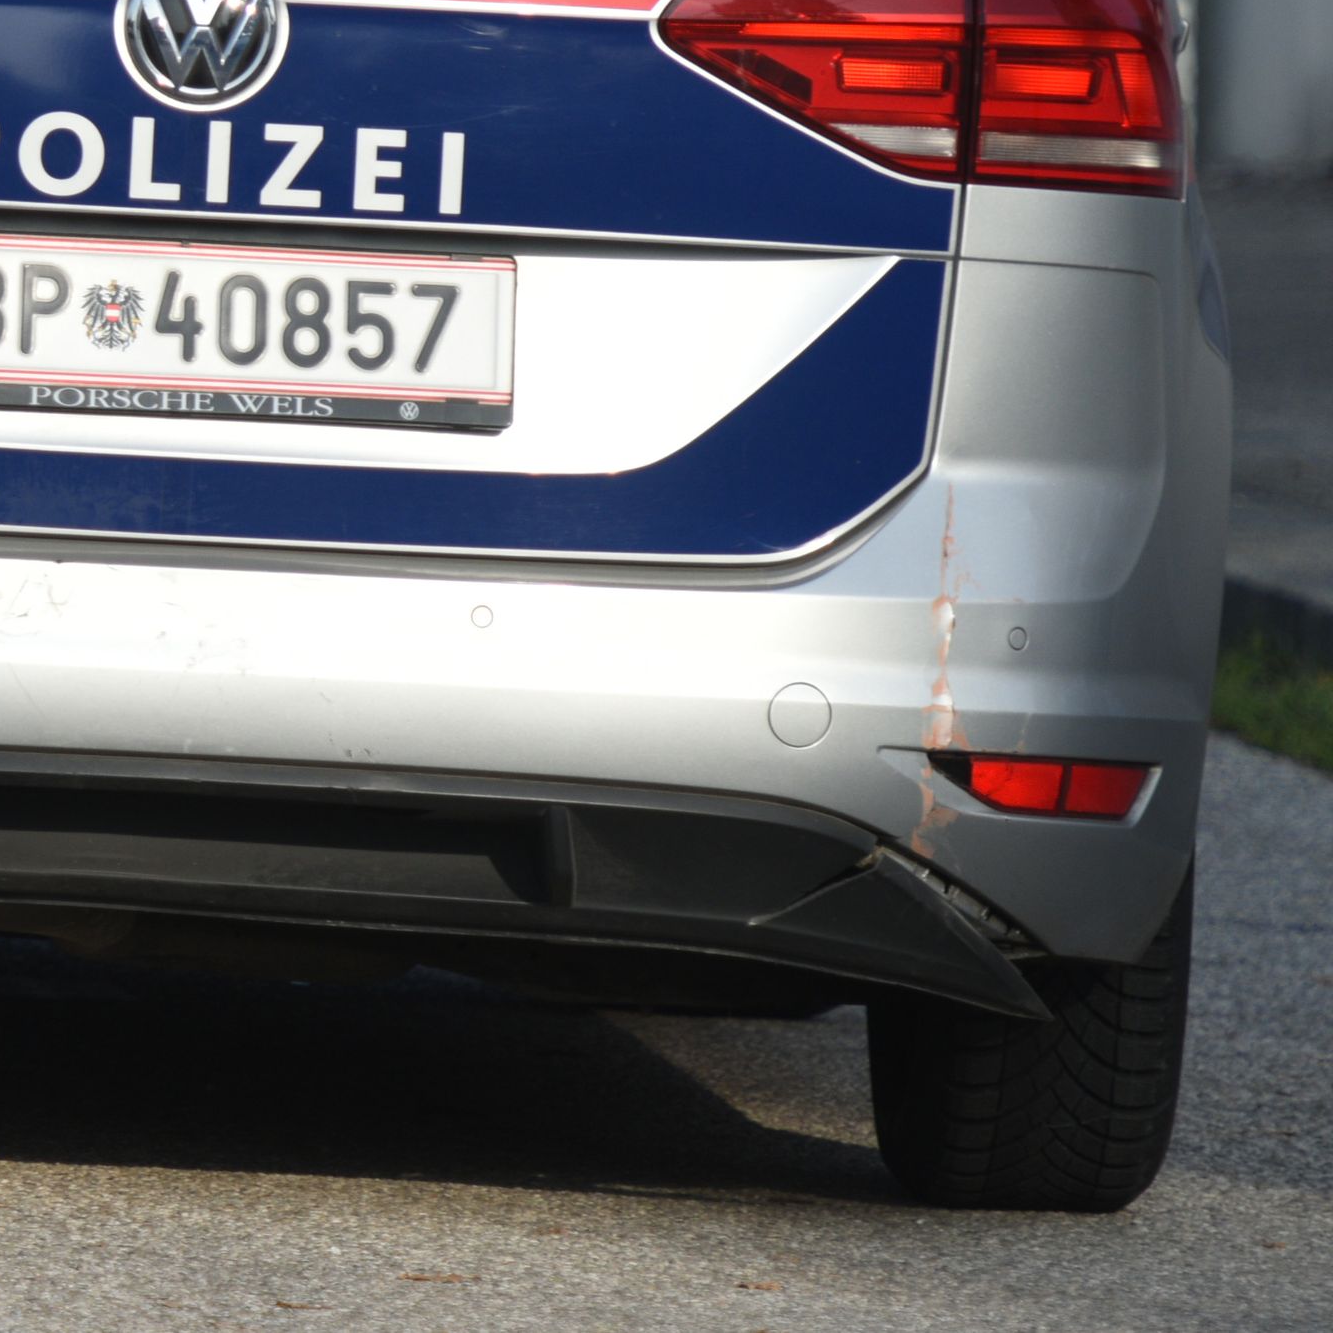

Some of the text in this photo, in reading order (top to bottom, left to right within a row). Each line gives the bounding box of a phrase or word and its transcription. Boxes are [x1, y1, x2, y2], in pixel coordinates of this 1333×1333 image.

[154, 269, 461, 374] 40857
[28, 385, 214, 412] PORSCHE
[227, 393, 334, 416] WELS
